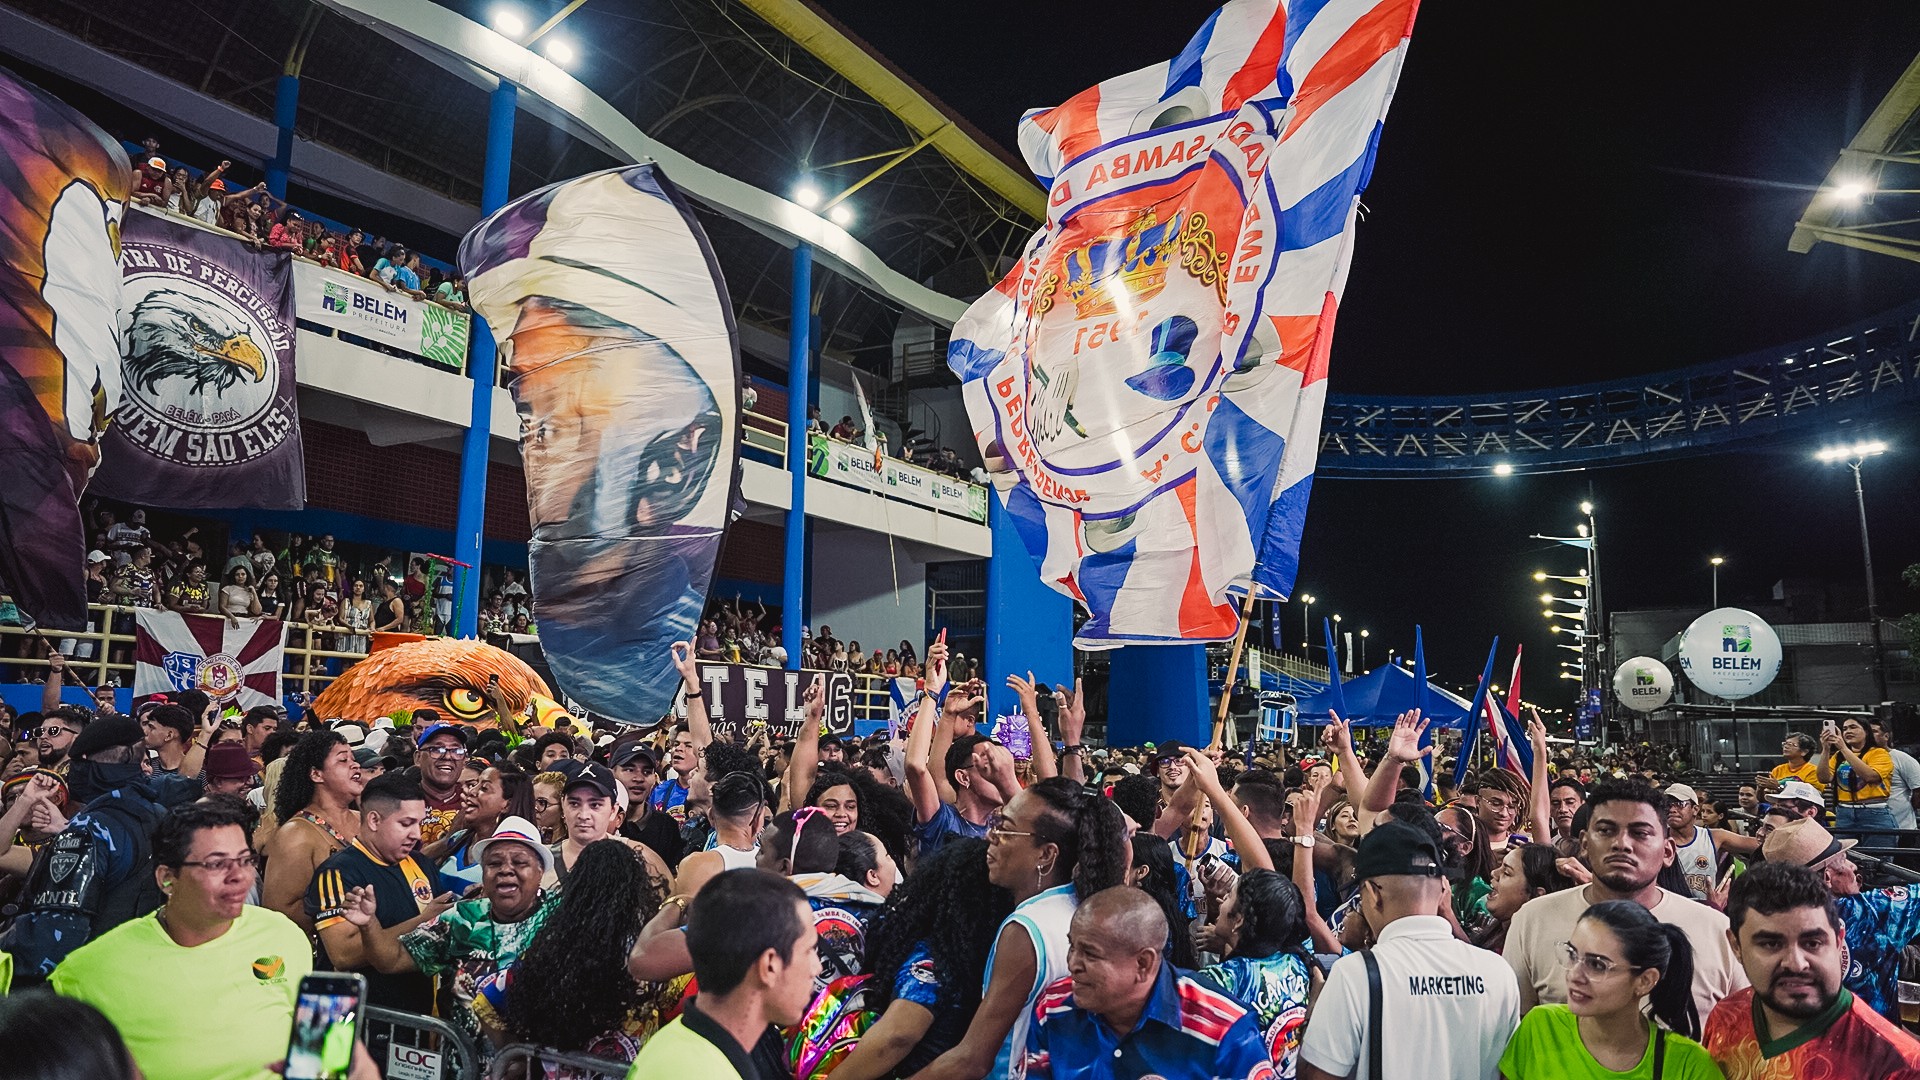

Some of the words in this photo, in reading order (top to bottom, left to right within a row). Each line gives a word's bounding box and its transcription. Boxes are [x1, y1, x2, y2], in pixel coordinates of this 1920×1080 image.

[120, 248, 162, 270] TRA
[163, 252, 193, 275] DE
[352, 292, 407, 325] BELÉM
[352, 311, 406, 333] PREFEITURA
[212, 407, 241, 424] PARÁ
[116, 398, 183, 457] UEM
[239, 406, 291, 450] ELES
[1712, 655, 1761, 670] BELÉM
[1409, 975, 1484, 995] MARKETING
[395, 1047, 436, 1069] LOC
